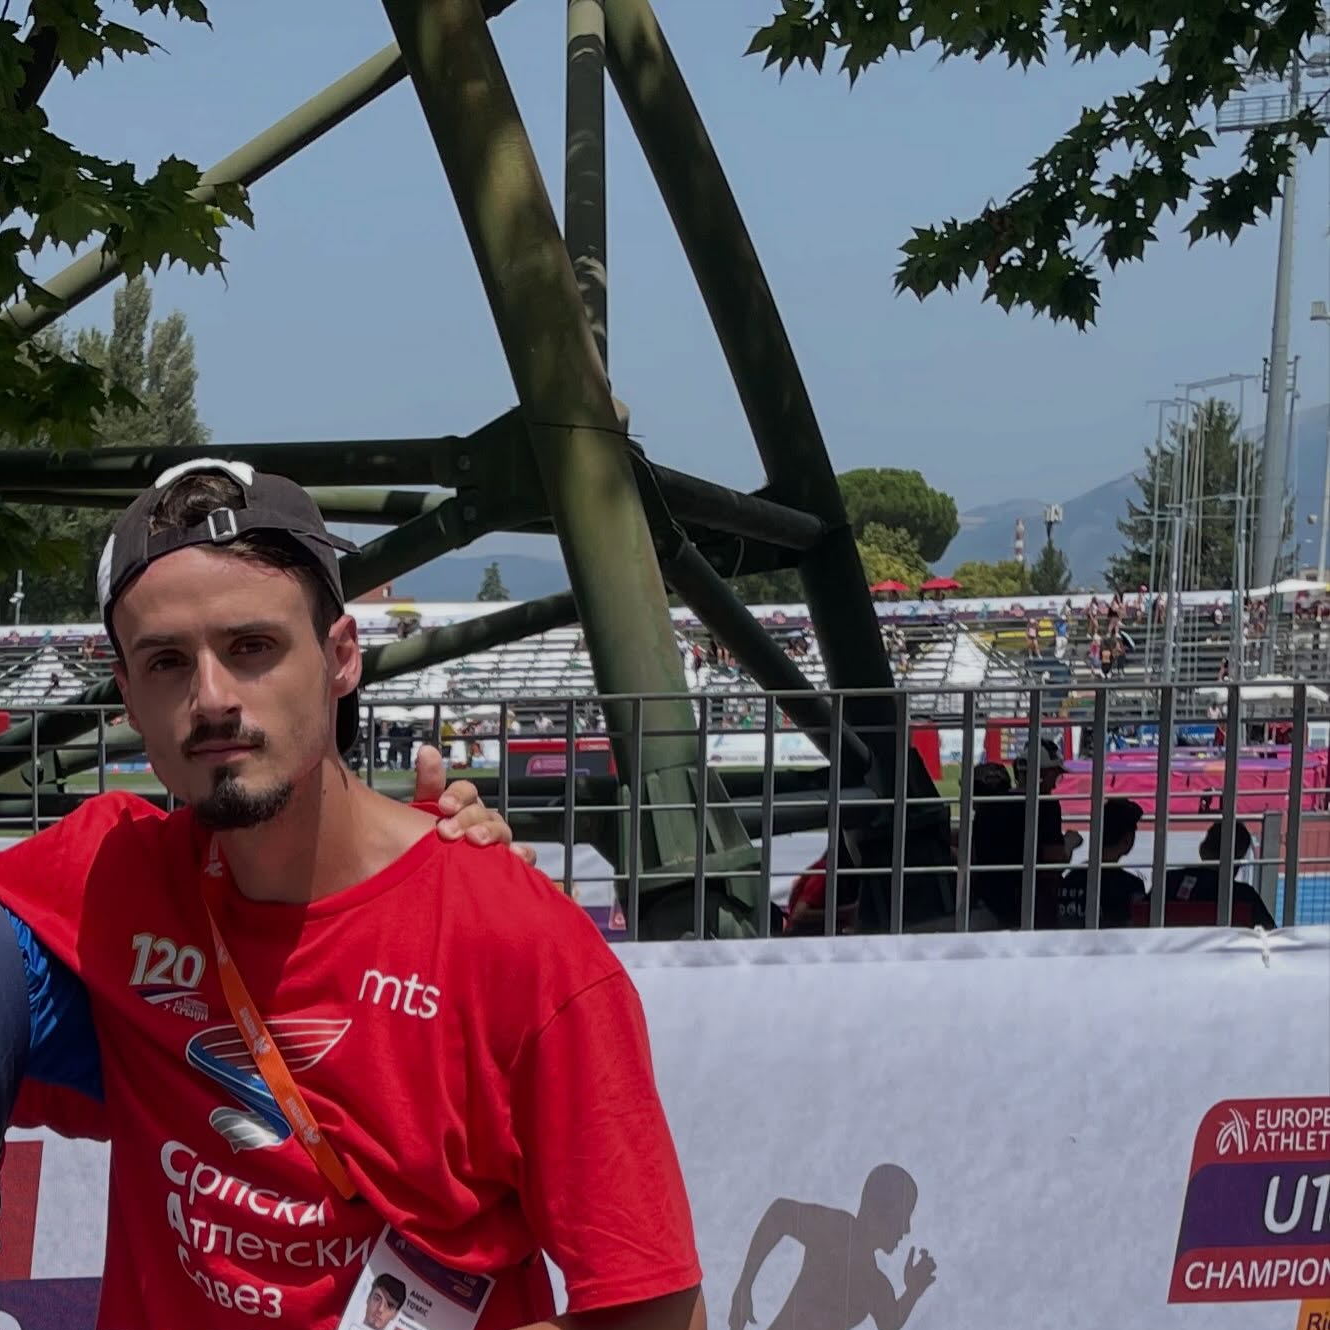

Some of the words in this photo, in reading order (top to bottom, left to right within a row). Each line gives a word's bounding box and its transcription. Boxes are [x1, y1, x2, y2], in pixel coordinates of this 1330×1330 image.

[129, 932, 206, 989] 120
[358, 969, 440, 1019] mts
[167, 1191, 372, 1267] Атлетски
[1264, 1174, 1330, 1234] U1
